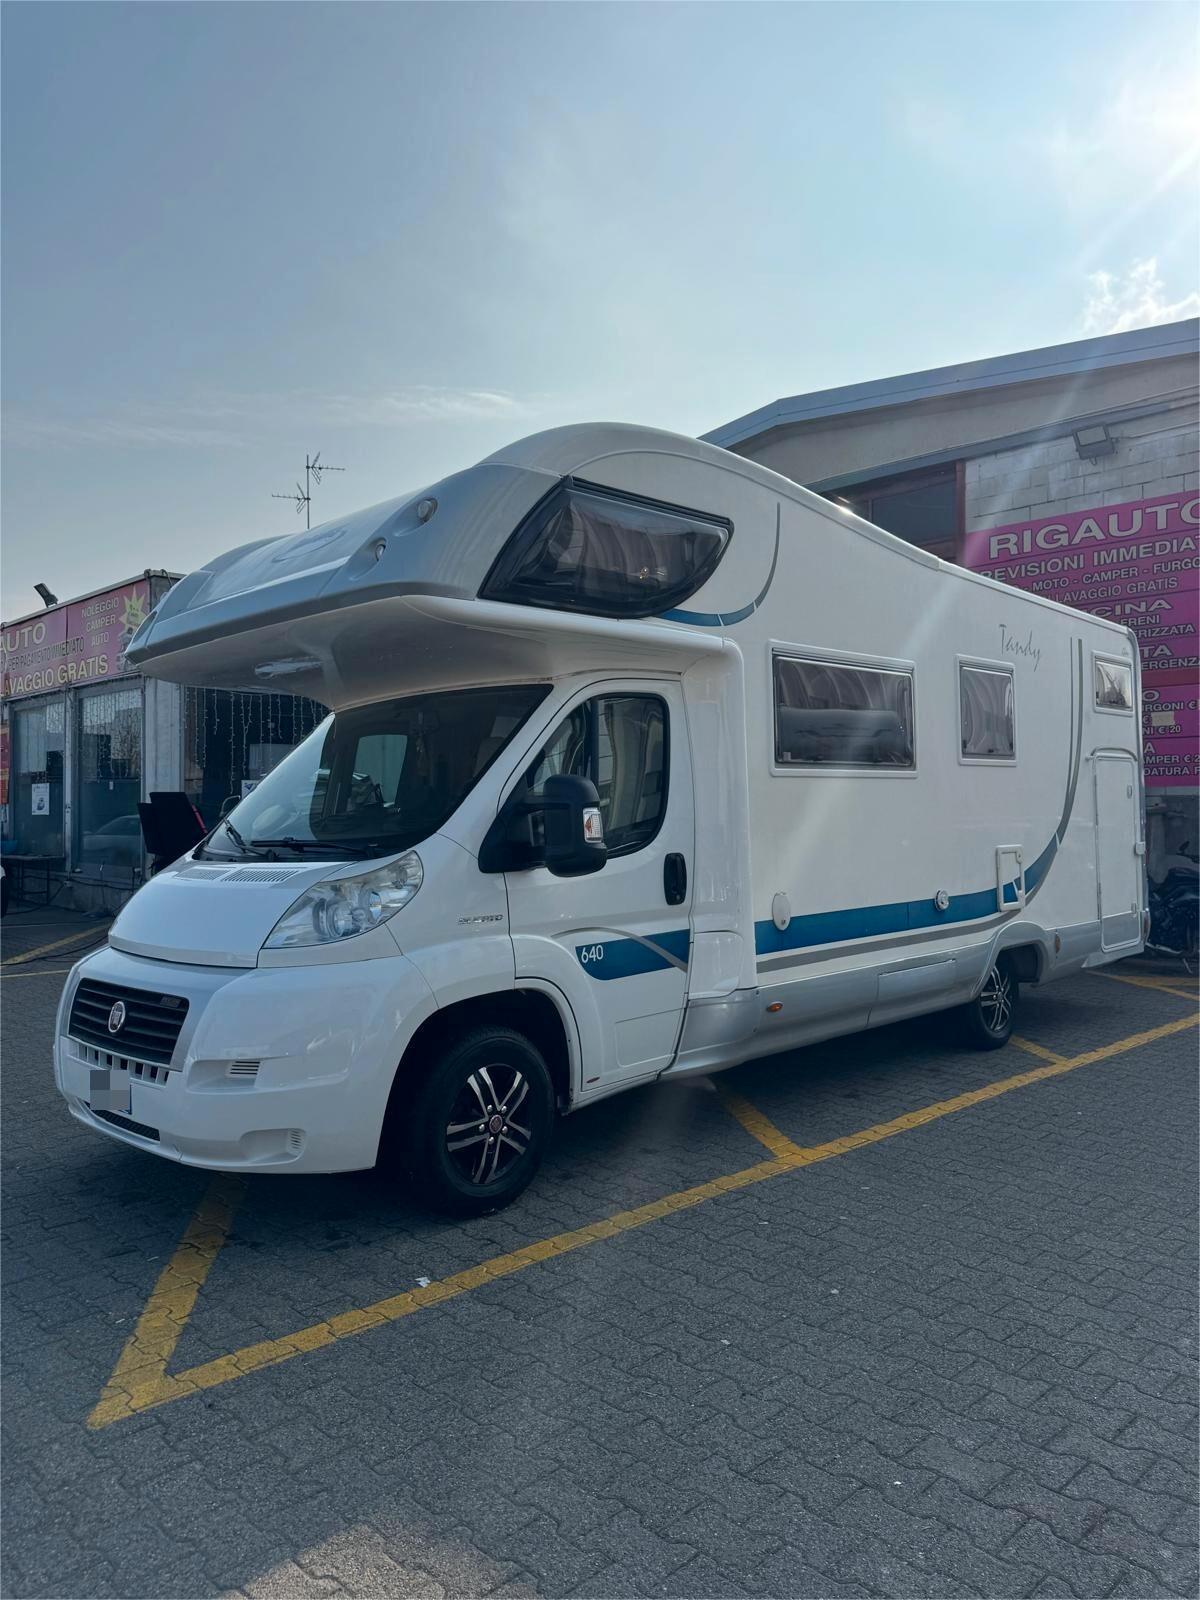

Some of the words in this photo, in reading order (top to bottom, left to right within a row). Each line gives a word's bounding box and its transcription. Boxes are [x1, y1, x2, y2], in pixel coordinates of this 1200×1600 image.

[1094, 535, 1199, 566] IMMEDIA
[1032, 577, 1069, 592] MOTO
[1083, 568, 1138, 584] CAMPER
[1126, 577, 1178, 596] GRATIS
[81, 597, 119, 618] NOLEGGIO
[1083, 599, 1172, 618] CINA
[86, 614, 116, 632] CAMPER
[999, 624, 1040, 672] Tandy
[1141, 657, 1199, 671] ERGENZ
[0, 668, 54, 697] AVAGGIO
[57, 654, 109, 684] GRATIS
[1142, 702, 1184, 712] RGONI
[1143, 755, 1180, 764] MPER
[580, 945, 604, 964] 640
